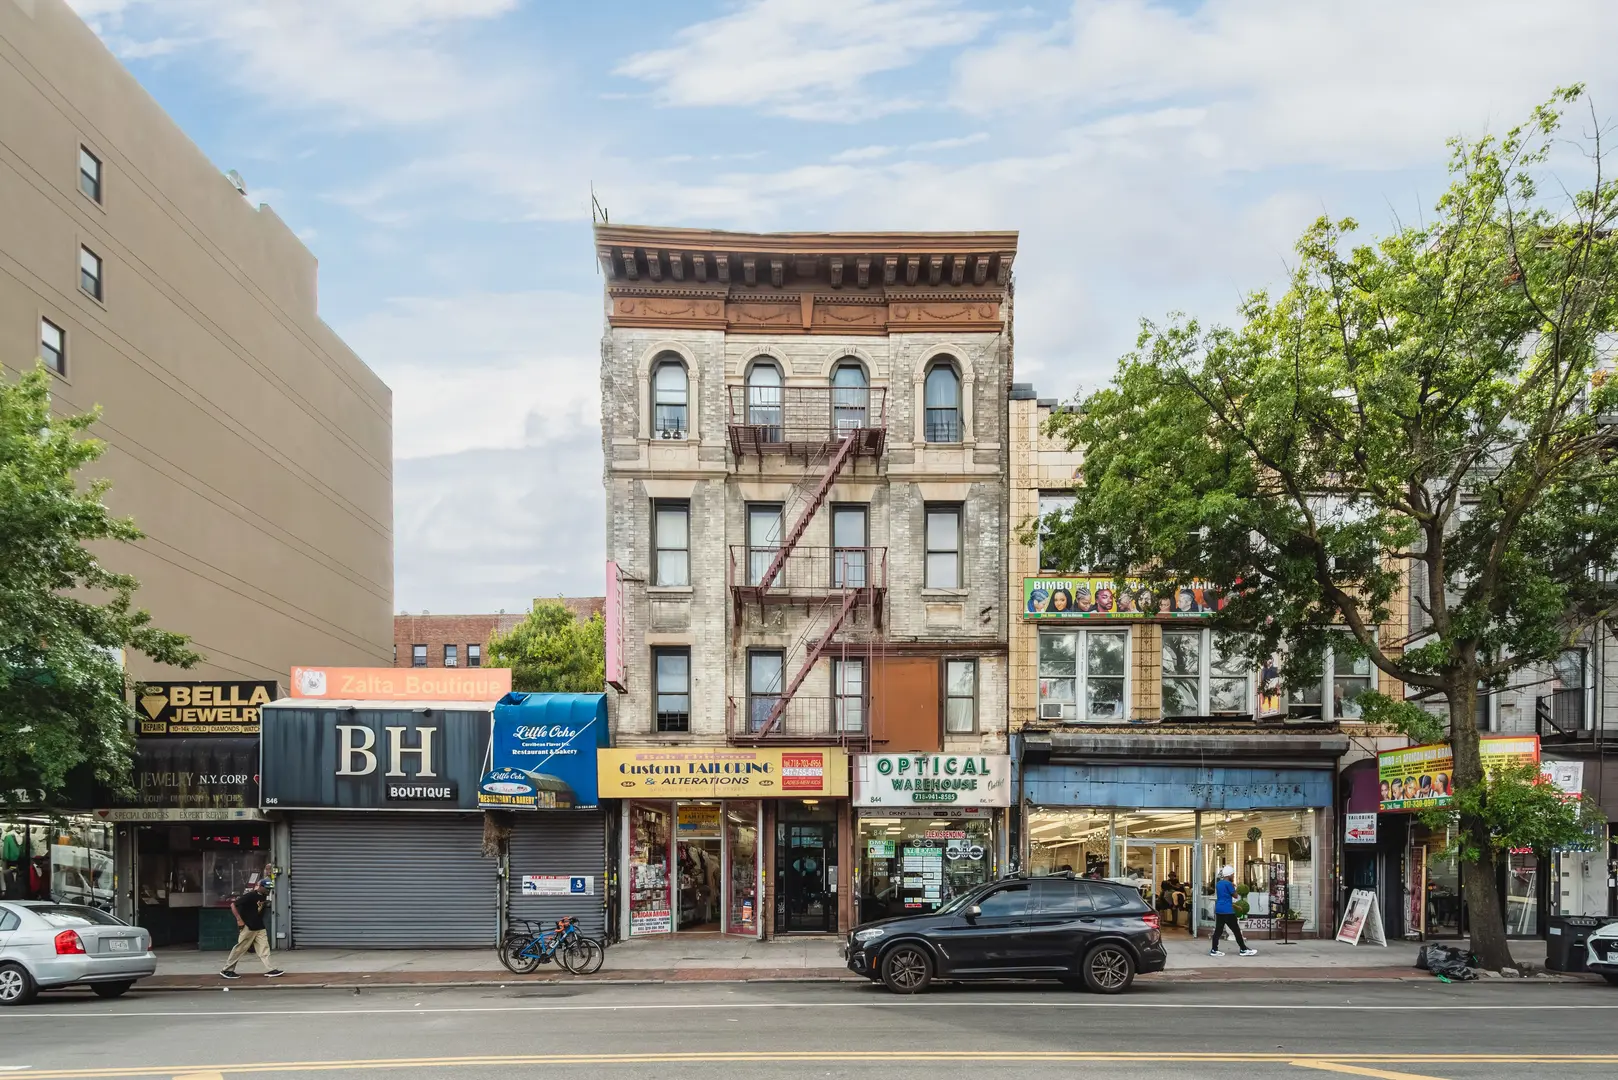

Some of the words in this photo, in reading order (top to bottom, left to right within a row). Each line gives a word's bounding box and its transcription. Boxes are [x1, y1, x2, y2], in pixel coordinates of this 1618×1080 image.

[1033, 580, 1073, 590] BIMBO
[1076, 580, 1090, 590] #1
[340, 676, 502, 697] Zalta_Boutique
[169, 685, 272, 706] BELLA
[143, 724, 165, 732] REPAIRS
[512, 725, 548, 740] Little
[335, 725, 438, 777] BH
[619, 762, 681, 774] Custom
[688, 762, 774, 774] TAILORING
[876, 756, 991, 776] OPTICAL
[199, 774, 218, 784] N.Y.
[220, 774, 248, 784] CORP
[645, 778, 657, 786] &
[661, 777, 750, 785] ALTERATIONS
[891, 778, 978, 791] WAREHOUSE
[390, 786, 451, 798] BOUTIQUE
[480, 794, 512, 804] RESTAURANT
[516, 795, 534, 804] BAKERY
[114, 810, 141, 820] SPECIAL
[142, 810, 170, 819] ORDERS
[180, 810, 204, 819] EXPERT
